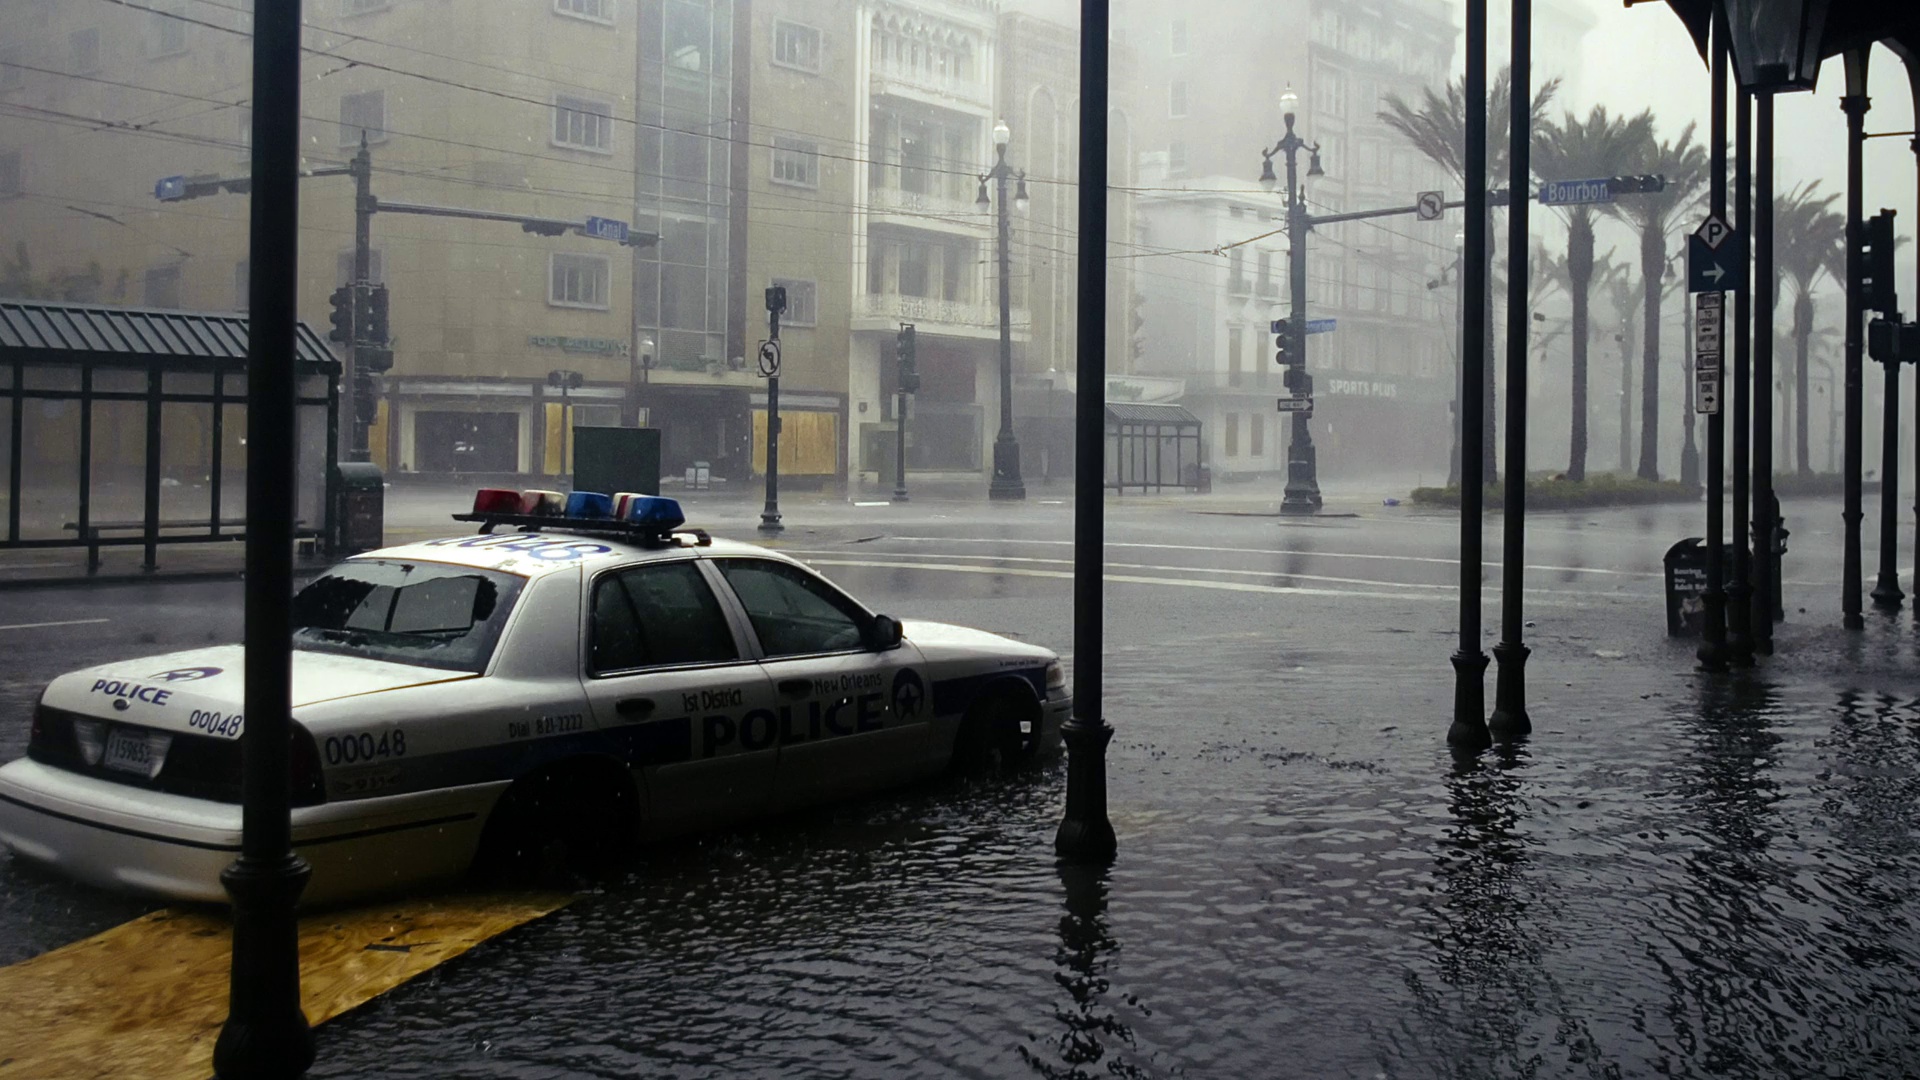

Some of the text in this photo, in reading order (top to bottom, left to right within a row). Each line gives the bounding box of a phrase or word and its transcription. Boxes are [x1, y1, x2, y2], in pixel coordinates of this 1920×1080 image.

[1548, 182, 1609, 201] Bourbon
[596, 219, 622, 239] Canal
[1708, 223, 1722, 243] P
[1329, 379, 1397, 398] SPORTS PLUS
[91, 679, 173, 706] POLICE
[814, 672, 882, 695] New Orleans
[702, 688, 743, 711] District
[189, 709, 243, 737] 00048
[508, 721, 530, 738] Dial
[702, 692, 884, 760] POLICE
[325, 728, 407, 765] 00048
